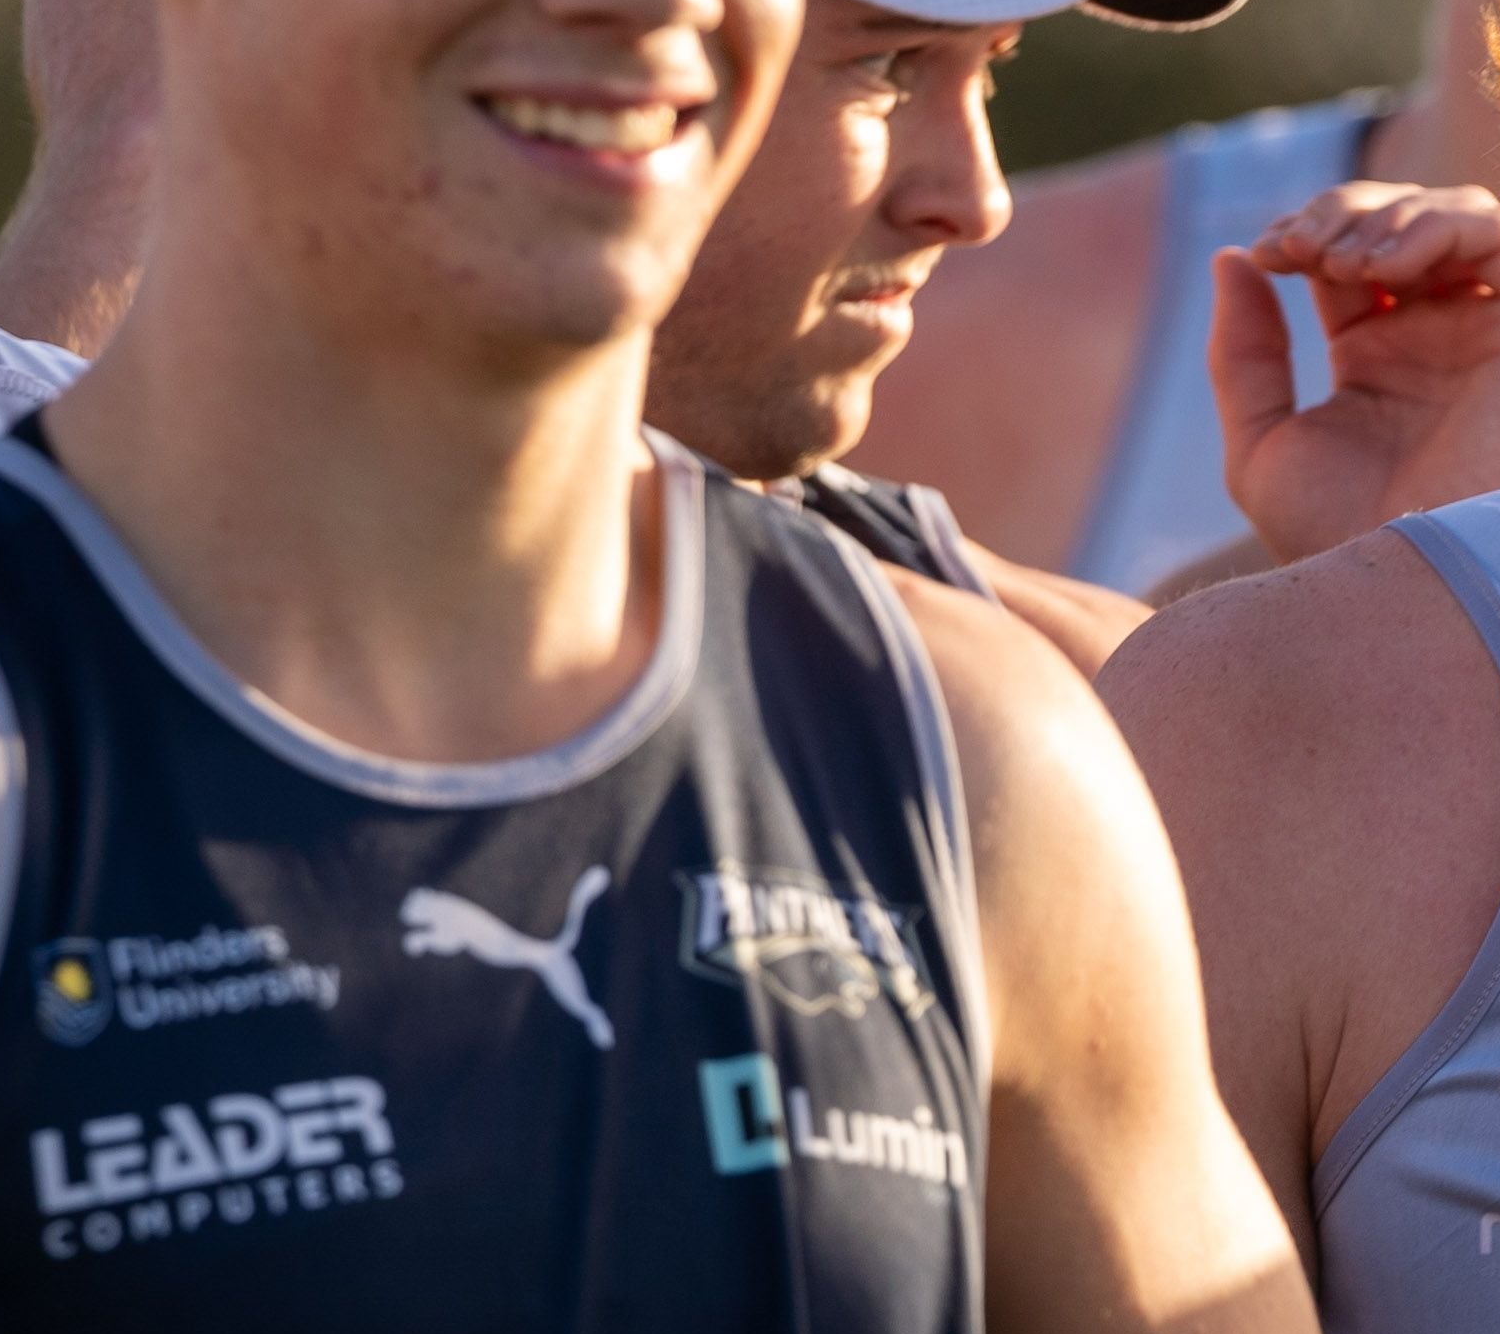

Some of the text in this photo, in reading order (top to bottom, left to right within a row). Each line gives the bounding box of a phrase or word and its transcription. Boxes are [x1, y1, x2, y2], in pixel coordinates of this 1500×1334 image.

[108, 925, 289, 980] Flinders
[117, 961, 340, 1029] University
[30, 1075, 395, 1215] LEADER
[788, 1086, 966, 1188] Lumin
[41, 1157, 404, 1259] COMPUTERS
